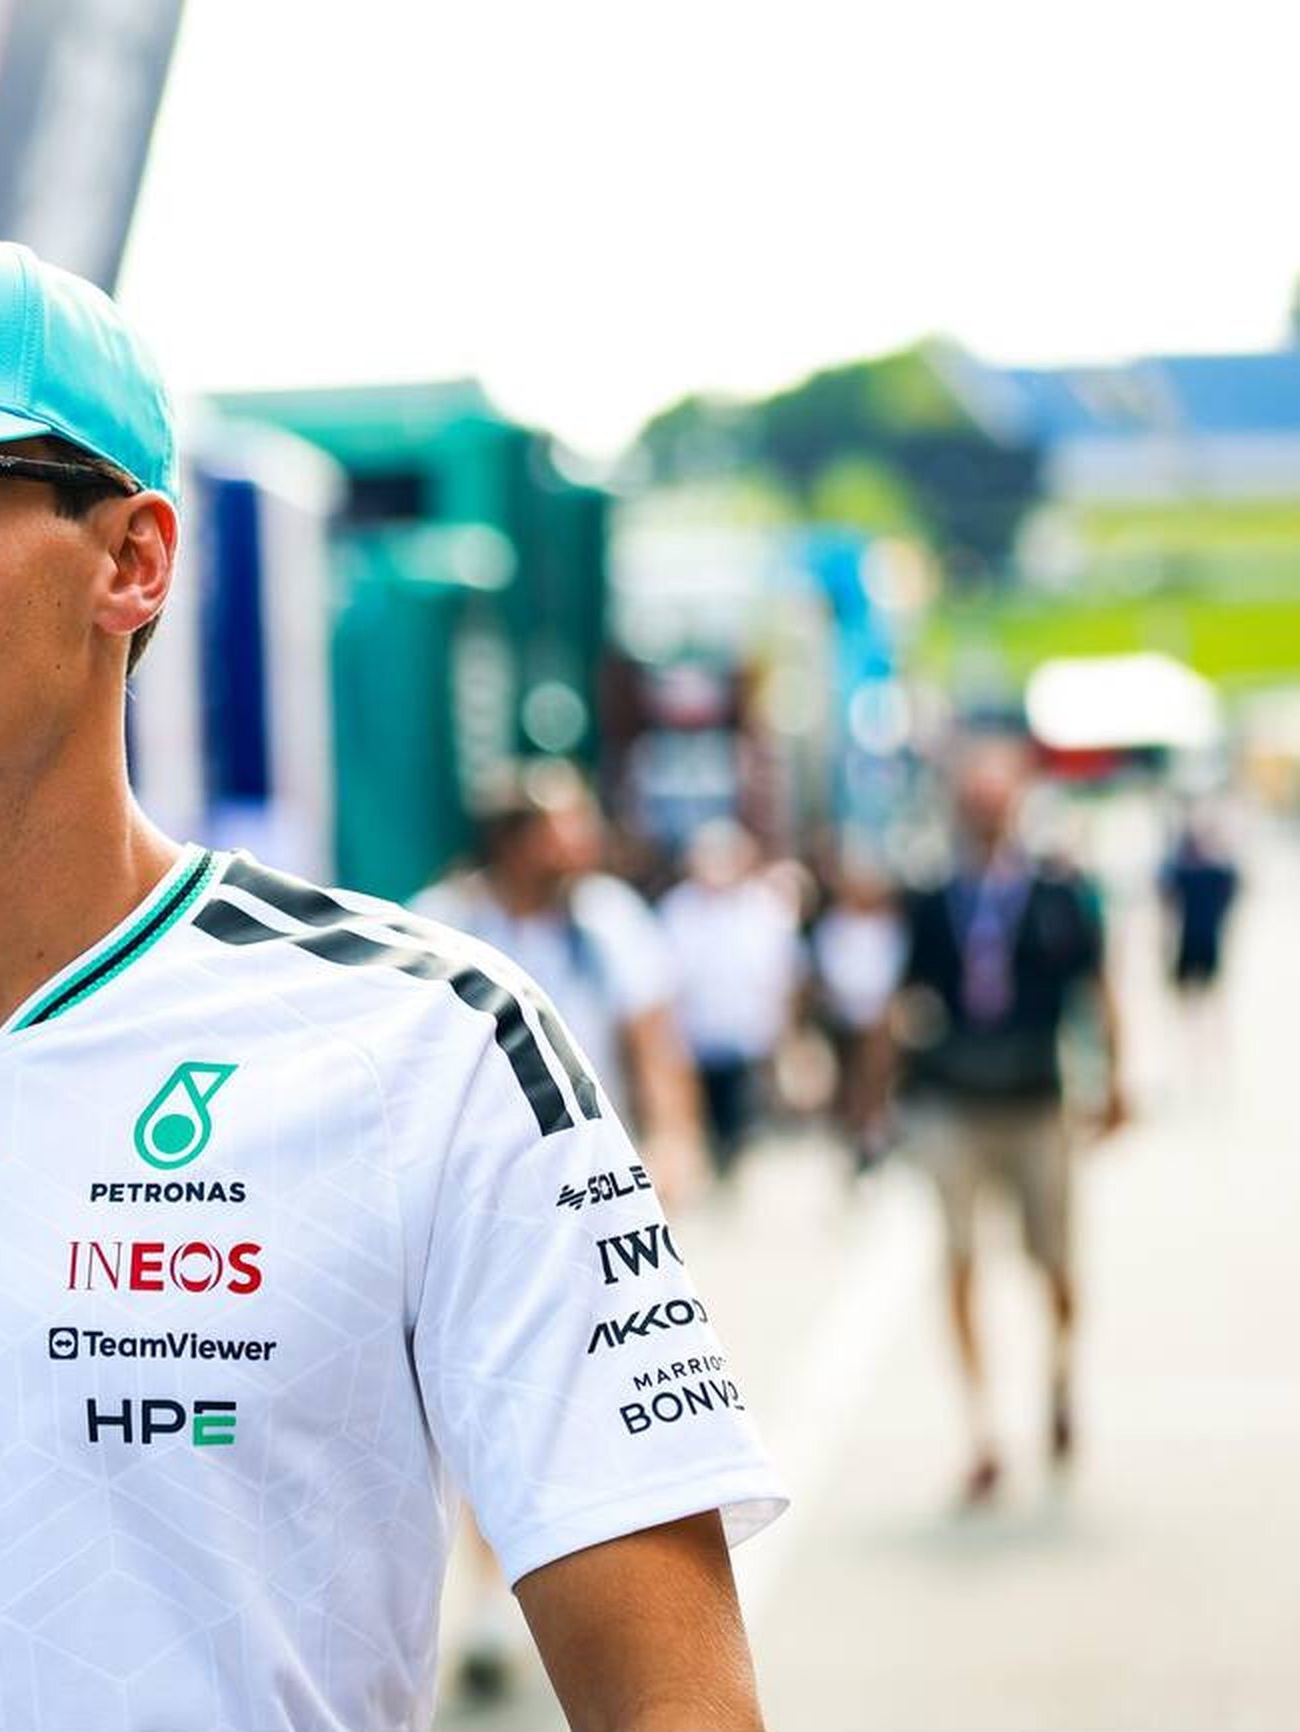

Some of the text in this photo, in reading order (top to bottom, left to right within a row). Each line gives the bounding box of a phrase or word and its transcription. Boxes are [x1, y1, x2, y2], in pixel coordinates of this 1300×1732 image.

[90, 1181, 247, 1203] PETRONAS
[66, 1241, 263, 1295] INEOS
[82, 1331, 277, 1361] TeamViewer
[633, 1356, 726, 1391] MARRIO
[86, 1398, 237, 1447] HPE
